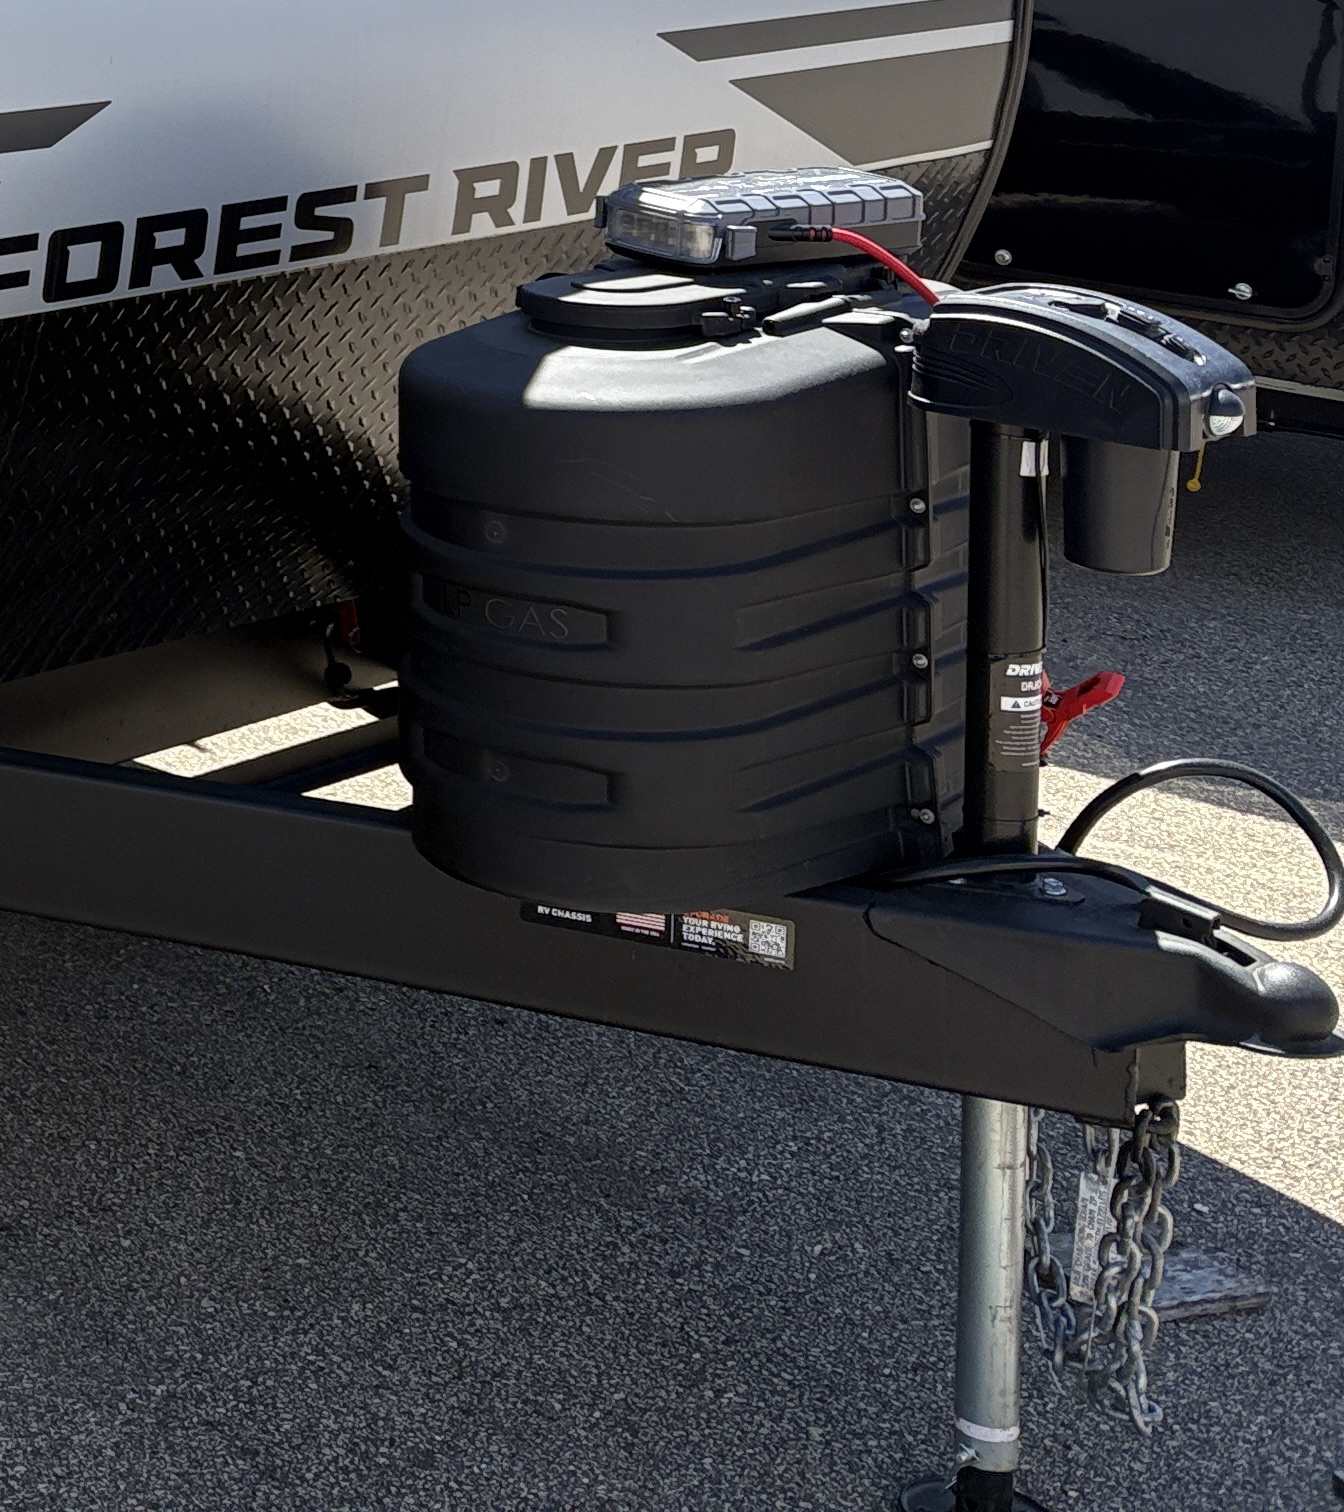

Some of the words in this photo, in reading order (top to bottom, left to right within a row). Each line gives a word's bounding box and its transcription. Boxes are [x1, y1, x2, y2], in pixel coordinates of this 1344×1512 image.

[484, 597, 570, 639] GAS
[537, 905, 550, 915] RV
[551, 908, 592, 923] CHASSIS
[682, 915, 709, 927] YOUR
[682, 924, 744, 943] EXPERIENCE
